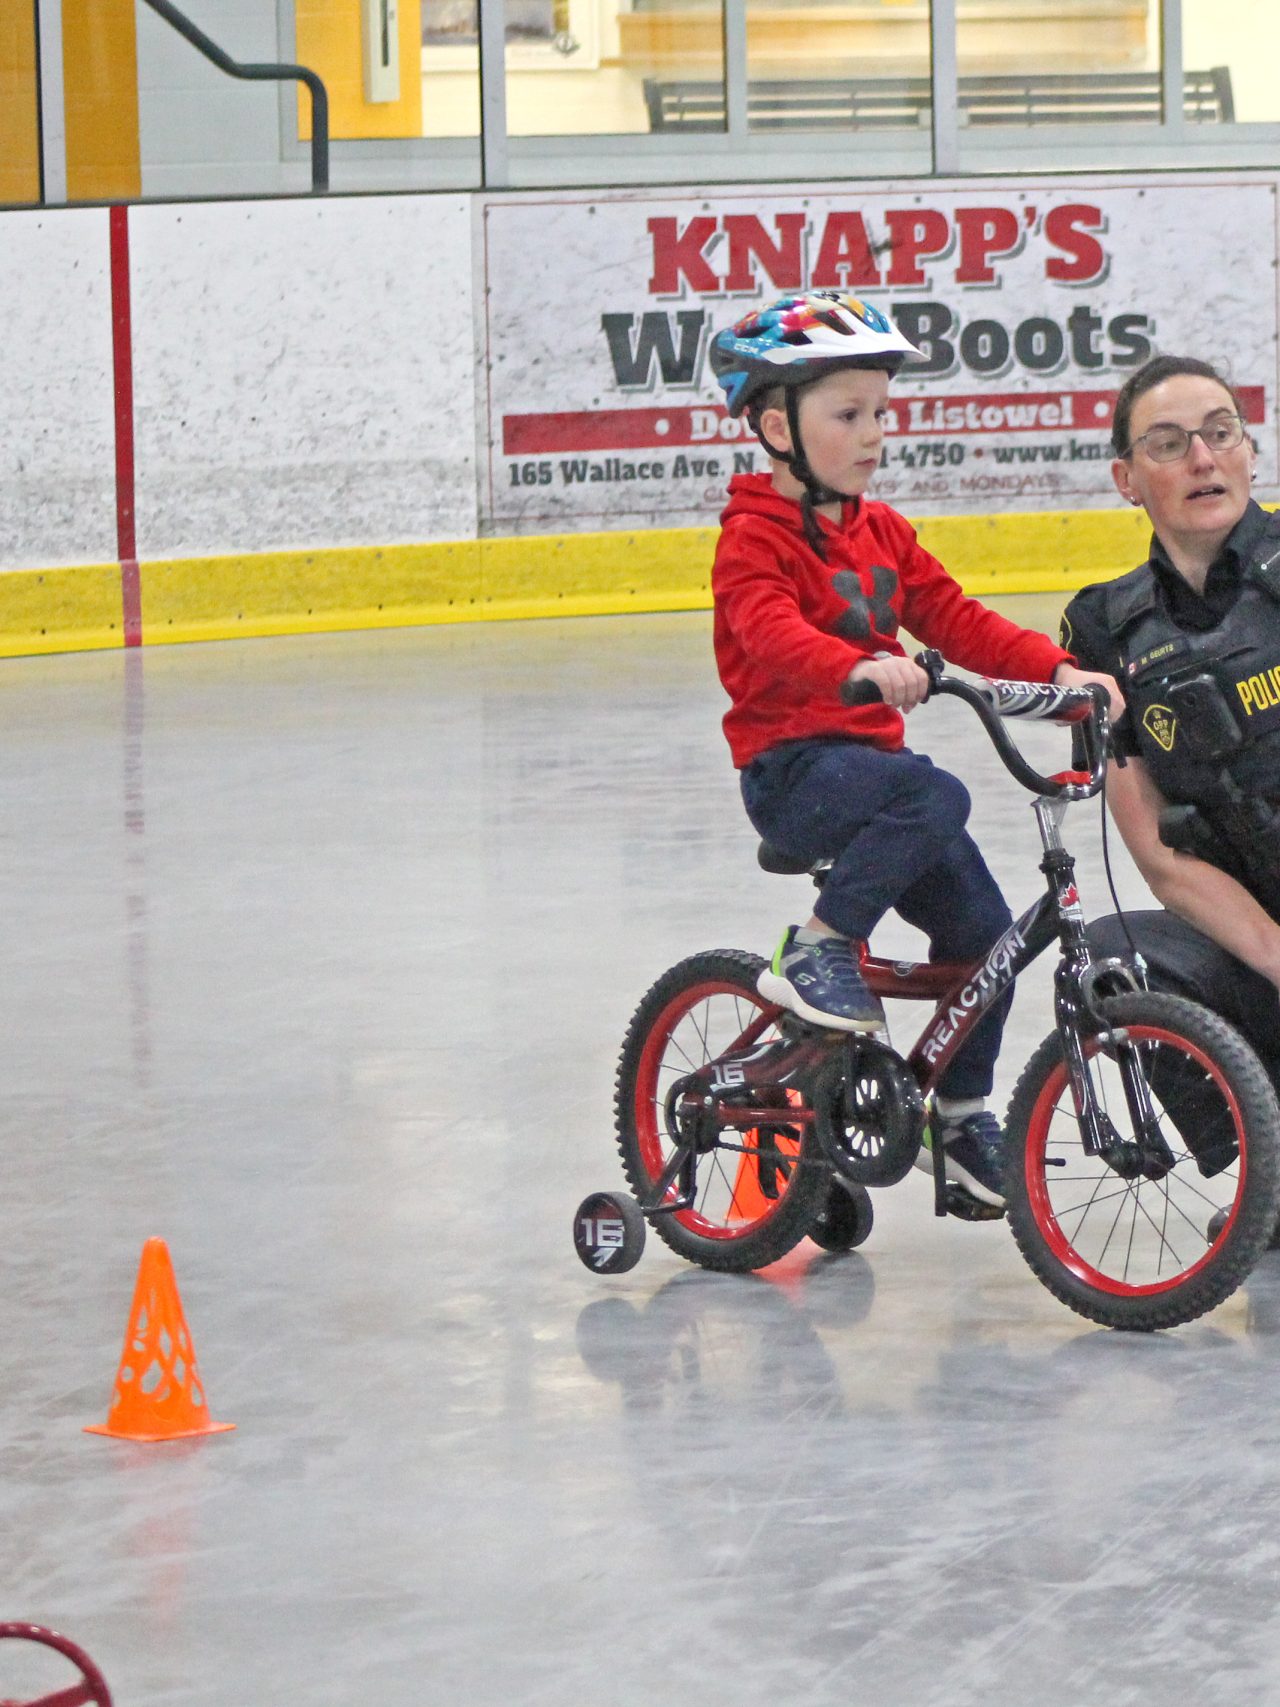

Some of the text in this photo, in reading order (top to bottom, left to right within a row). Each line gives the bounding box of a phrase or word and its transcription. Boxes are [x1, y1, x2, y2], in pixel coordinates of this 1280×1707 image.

[647, 204, 1106, 296] KNAPP'S
[892, 302, 1153, 375] Boots
[908, 396, 1074, 433] Listowel
[508, 461, 553, 487] 165
[560, 454, 665, 486] Wallace
[672, 451, 727, 480] Ave.
[921, 930, 1026, 1064] REACTION
[711, 1062, 746, 1085] 16
[580, 1218, 624, 1248] 16
